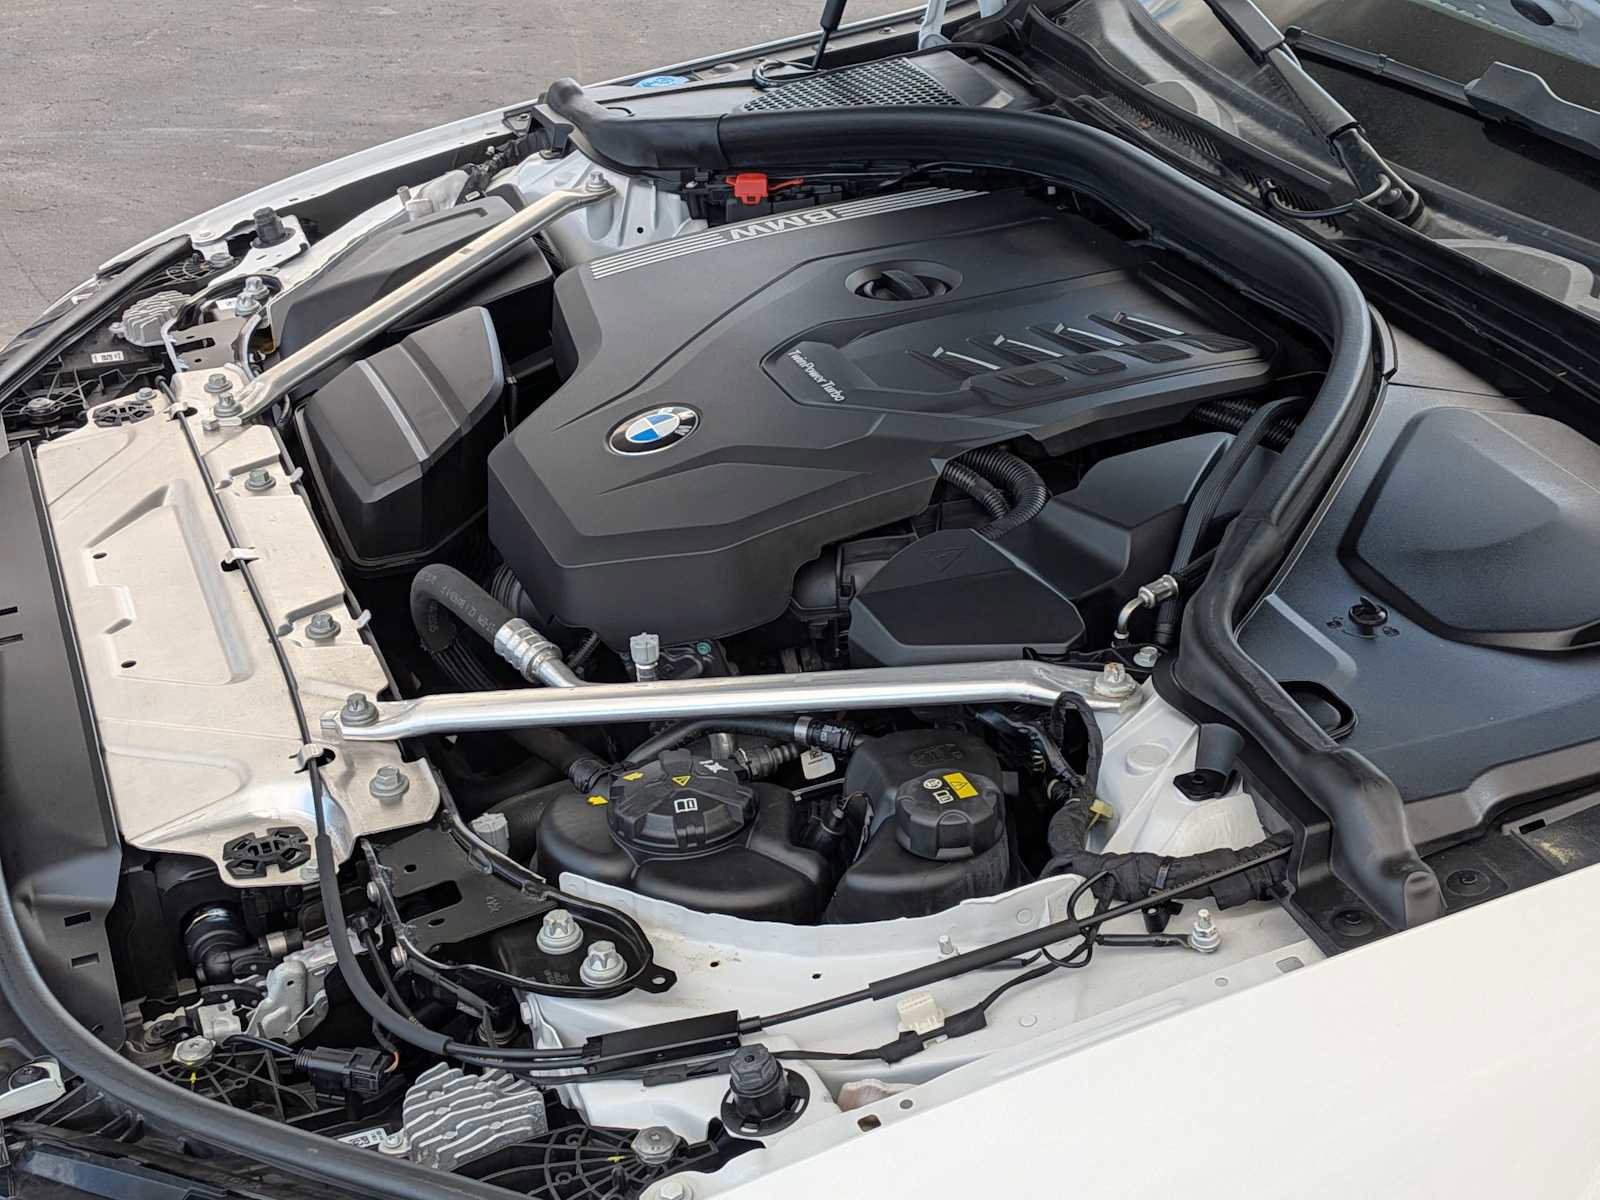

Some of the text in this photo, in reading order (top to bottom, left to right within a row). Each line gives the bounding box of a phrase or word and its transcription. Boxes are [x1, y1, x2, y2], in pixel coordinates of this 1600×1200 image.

[730, 209, 836, 240] BMW
[788, 349, 845, 401] TwinPower Turbo
